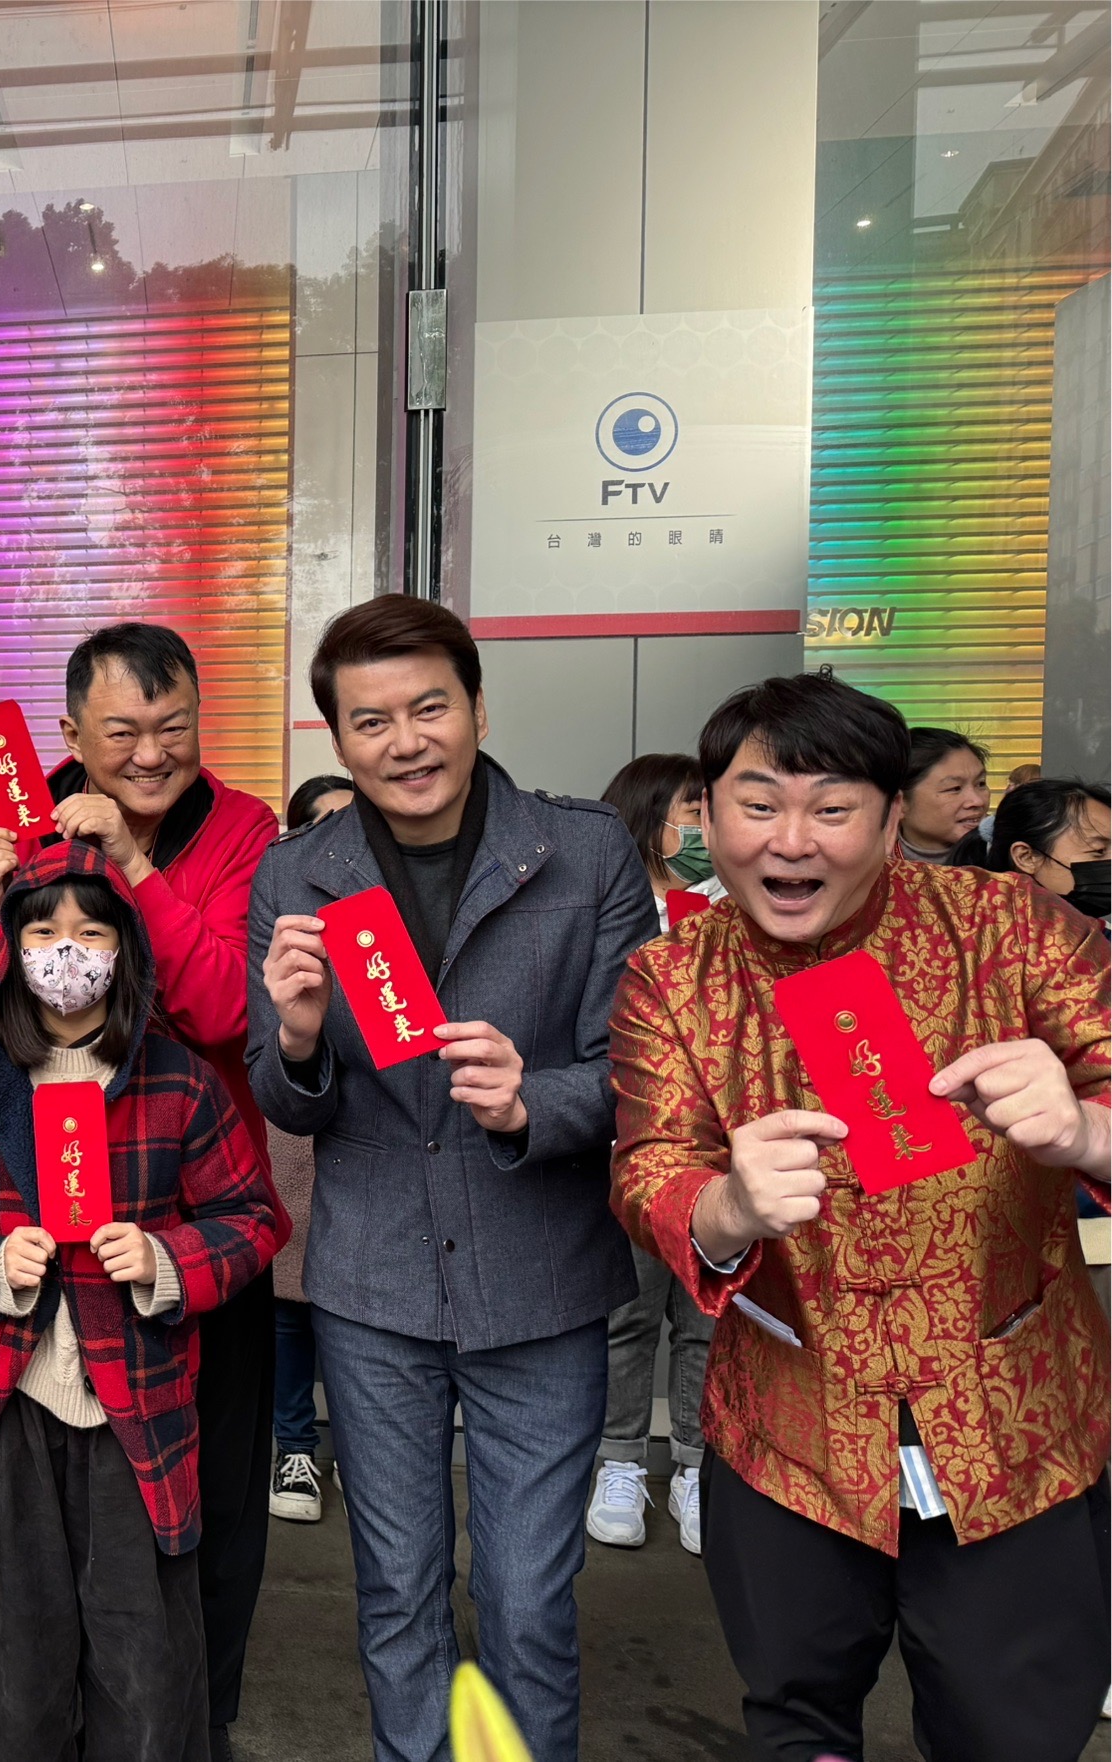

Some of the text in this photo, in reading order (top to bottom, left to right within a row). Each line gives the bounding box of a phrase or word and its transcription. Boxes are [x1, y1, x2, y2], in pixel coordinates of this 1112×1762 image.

[600, 479, 670, 506] FTV
[546, 528, 724, 549] 台灣的眼睛
[806, 606, 897, 638] SION
